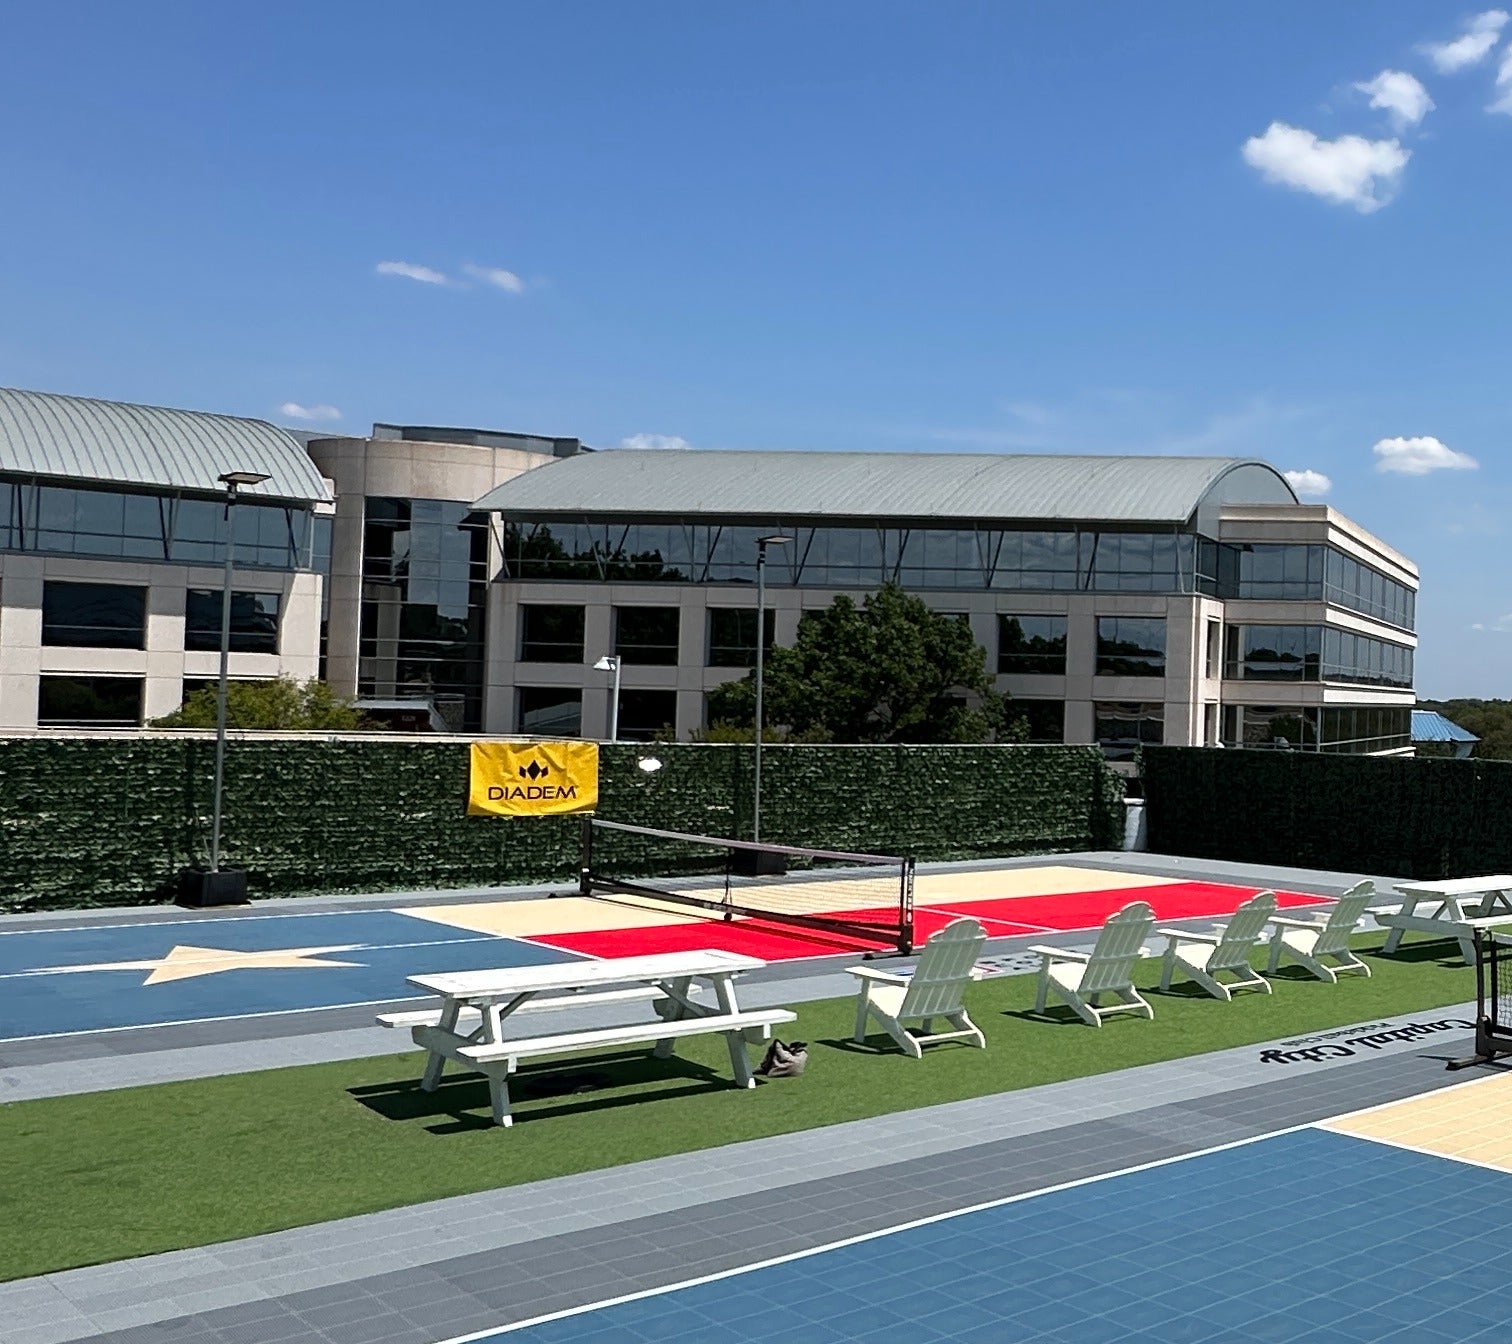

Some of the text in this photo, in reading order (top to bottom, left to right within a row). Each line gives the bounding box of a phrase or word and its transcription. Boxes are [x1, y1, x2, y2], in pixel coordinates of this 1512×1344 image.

[488, 785, 577, 800] DIADEM
[1259, 1018, 1478, 1065] Capital City
